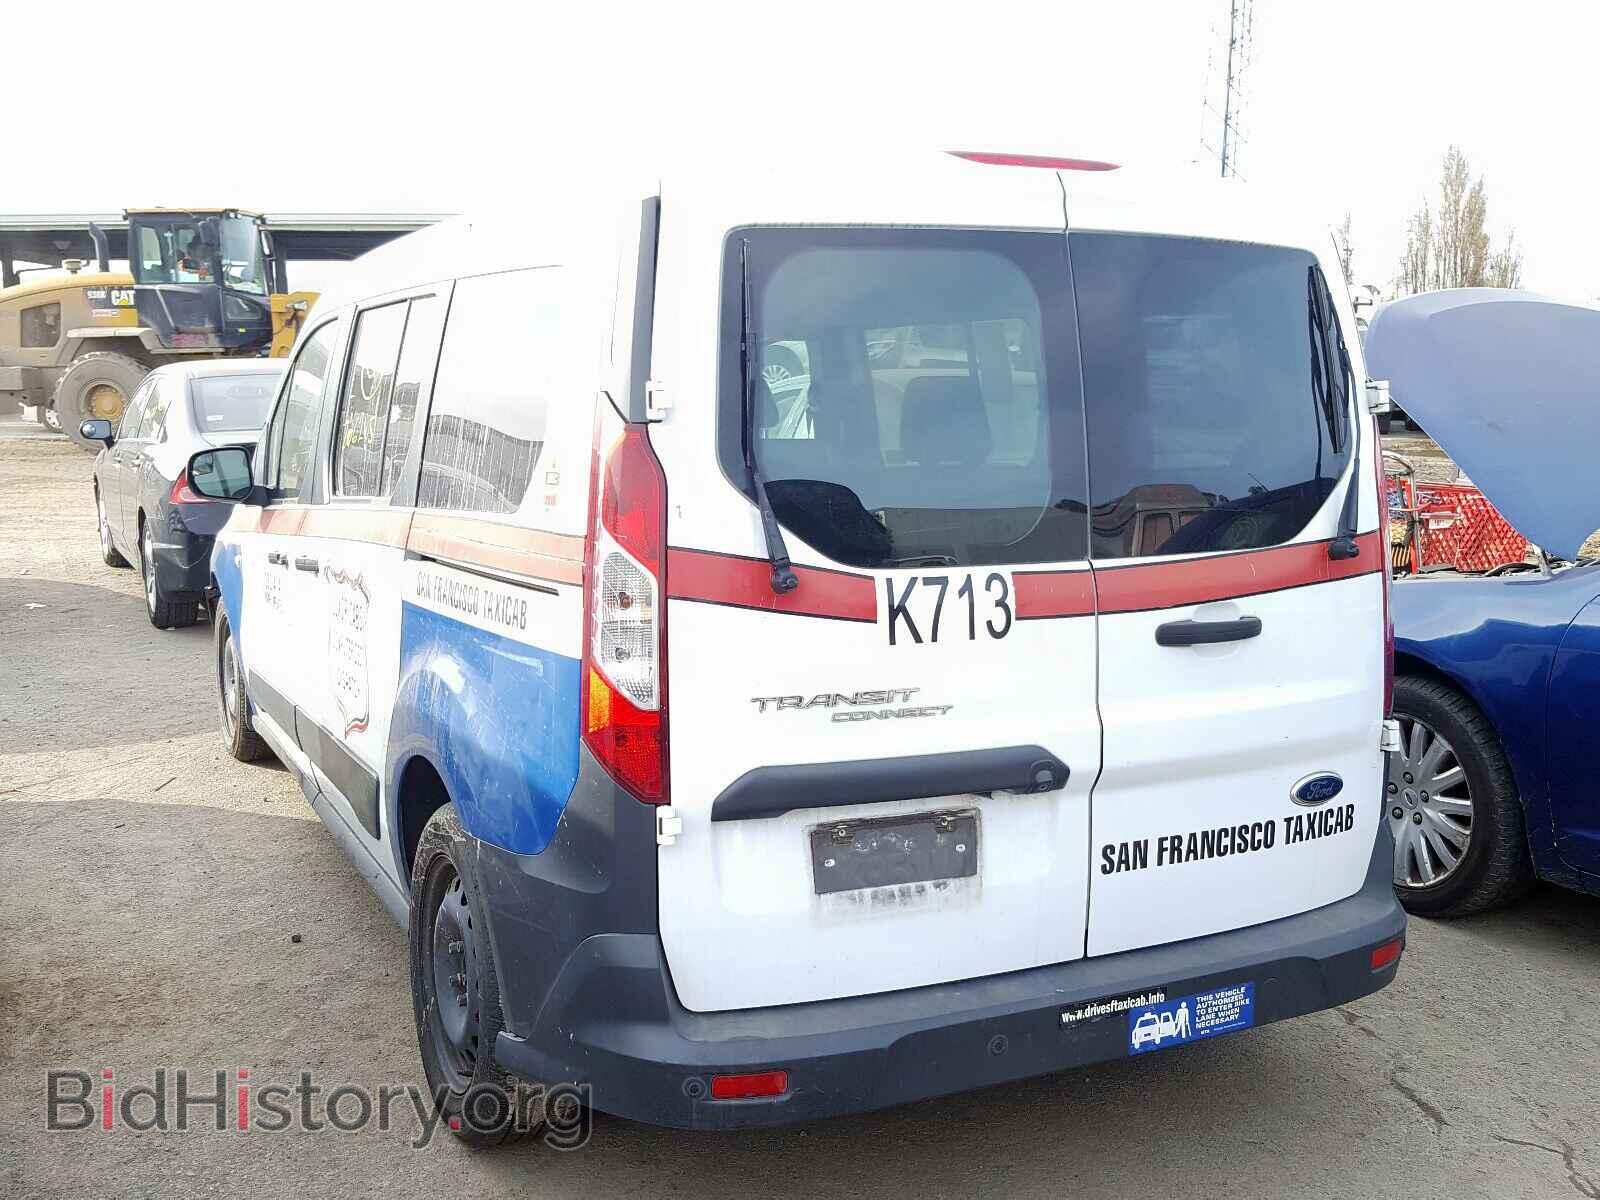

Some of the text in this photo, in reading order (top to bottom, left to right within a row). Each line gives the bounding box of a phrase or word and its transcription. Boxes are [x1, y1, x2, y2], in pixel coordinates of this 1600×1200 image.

[111, 290, 136, 305] CAT
[416, 570, 528, 630] SAN FRANCISCO TAXICAB
[886, 572, 1012, 645] K713
[751, 687, 921, 713] TRANSIT
[831, 704, 954, 722] CONNECT
[1306, 780, 1336, 800] Ford
[1100, 804, 1355, 875] SAN FRANCISCO TAXICAB
[1196, 986, 1246, 1003] THIS VEHICLE
[1196, 994, 1244, 1009] AUTHORIZED
[1207, 1003, 1233, 1013] ENTER
[1234, 998, 1250, 1007] BIKE
[1195, 1007, 1240, 1023] LANE WHEN
[1195, 1013, 1240, 1029] NECESSARY
